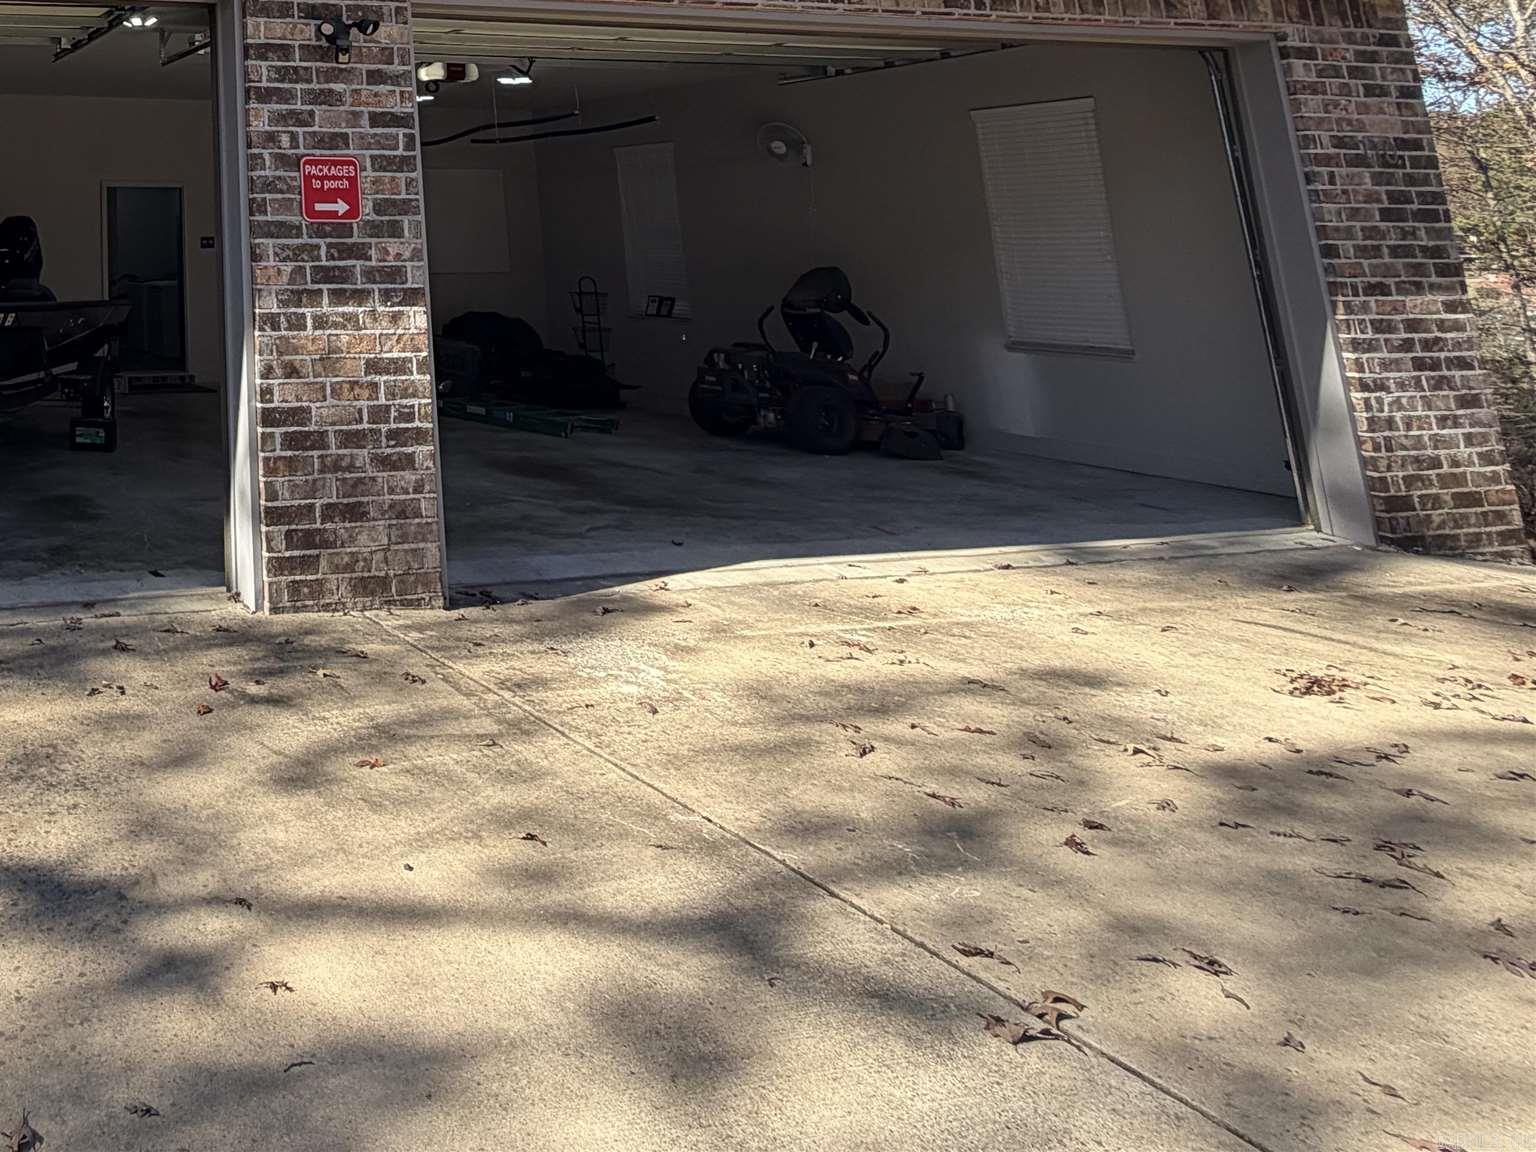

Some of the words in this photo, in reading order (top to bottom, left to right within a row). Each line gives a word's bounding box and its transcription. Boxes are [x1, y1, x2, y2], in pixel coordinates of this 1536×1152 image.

[305, 165, 355, 176] PACKAGES
[312, 179, 321, 189] to
[324, 179, 349, 190] porch
